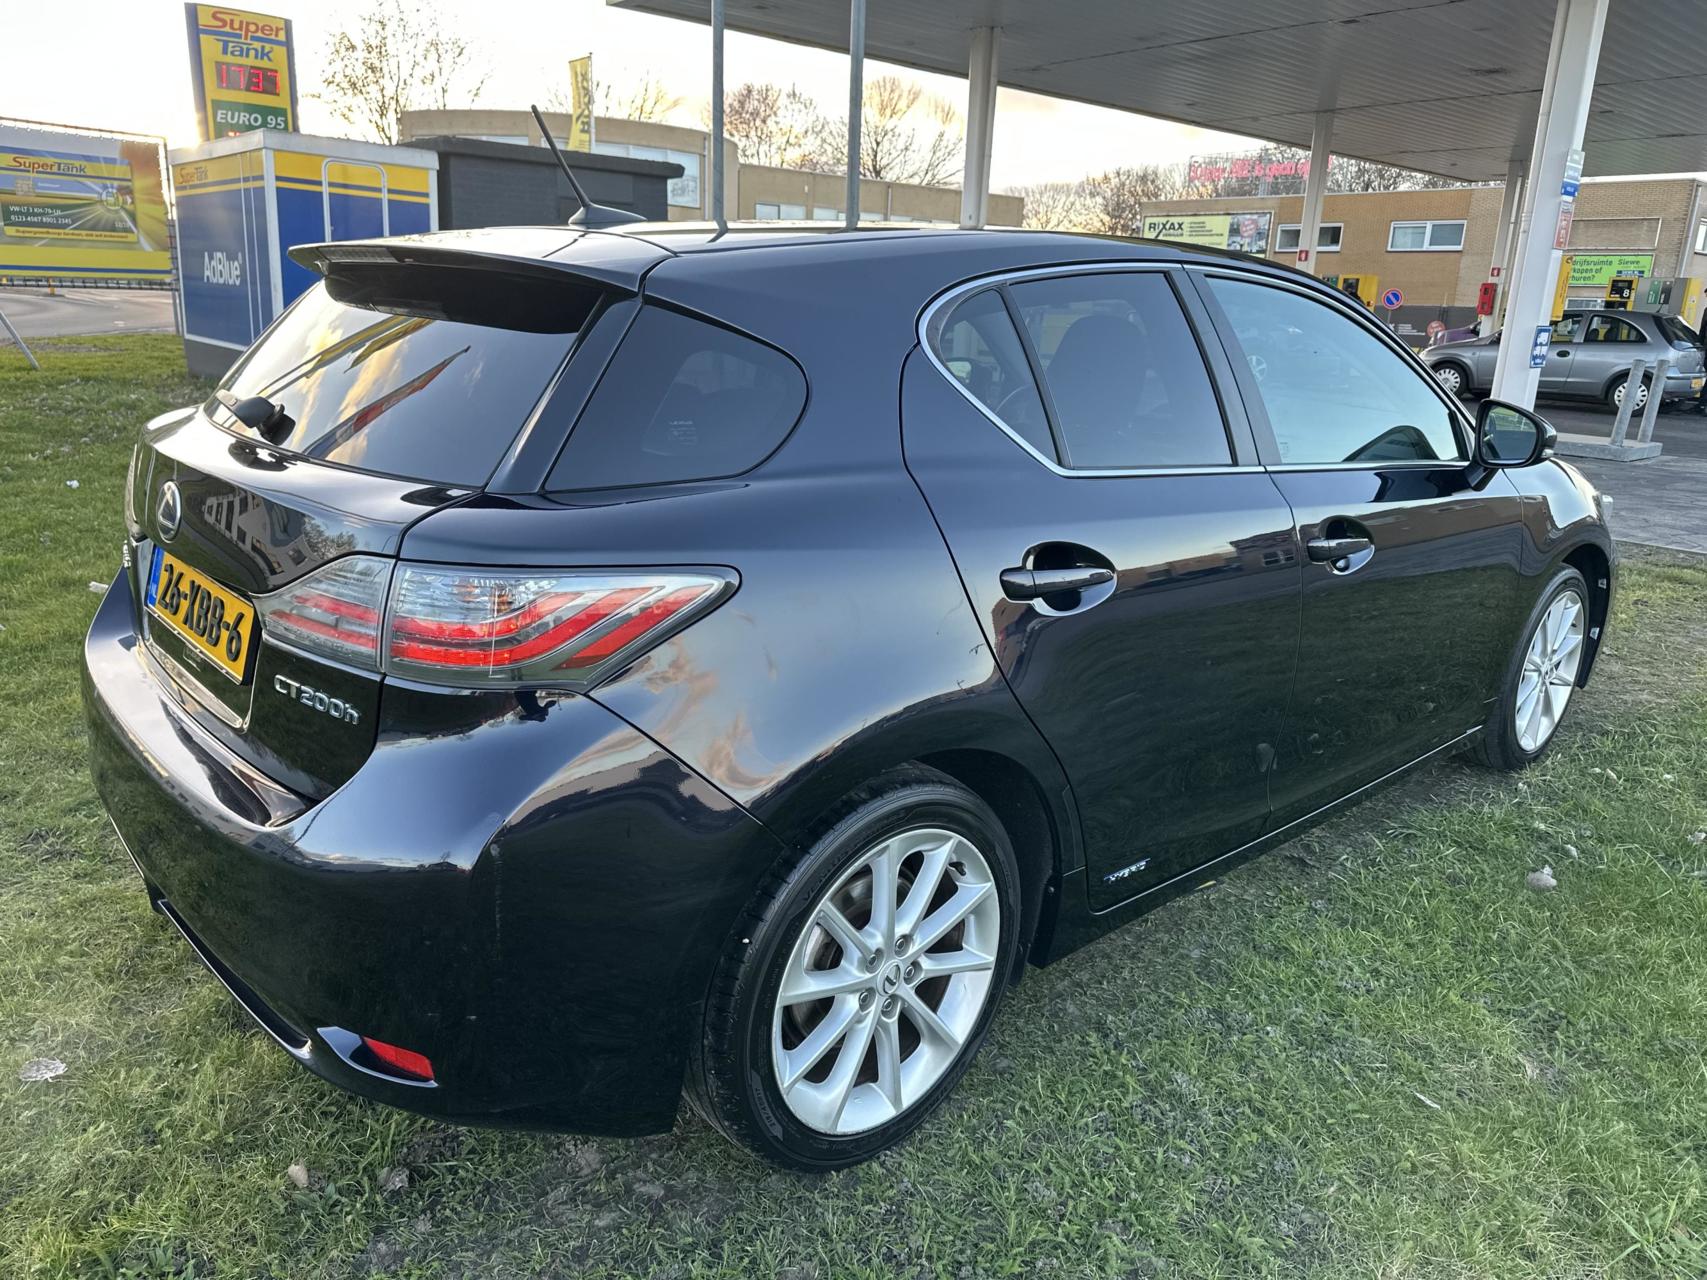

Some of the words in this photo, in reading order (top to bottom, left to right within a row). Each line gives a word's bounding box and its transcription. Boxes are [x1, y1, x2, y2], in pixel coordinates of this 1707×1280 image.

[199, 10, 284, 41] Super
[213, 38, 274, 62] Tank
[216, 110, 262, 126] EURO
[267, 115, 286, 129] 95
[8, 156, 87, 174] SuperTank
[1148, 219, 1184, 239] RIXAX
[1623, 289, 1630, 297] 8
[156, 562, 246, 662] 26-XBB-6
[273, 673, 360, 726] CT200h
